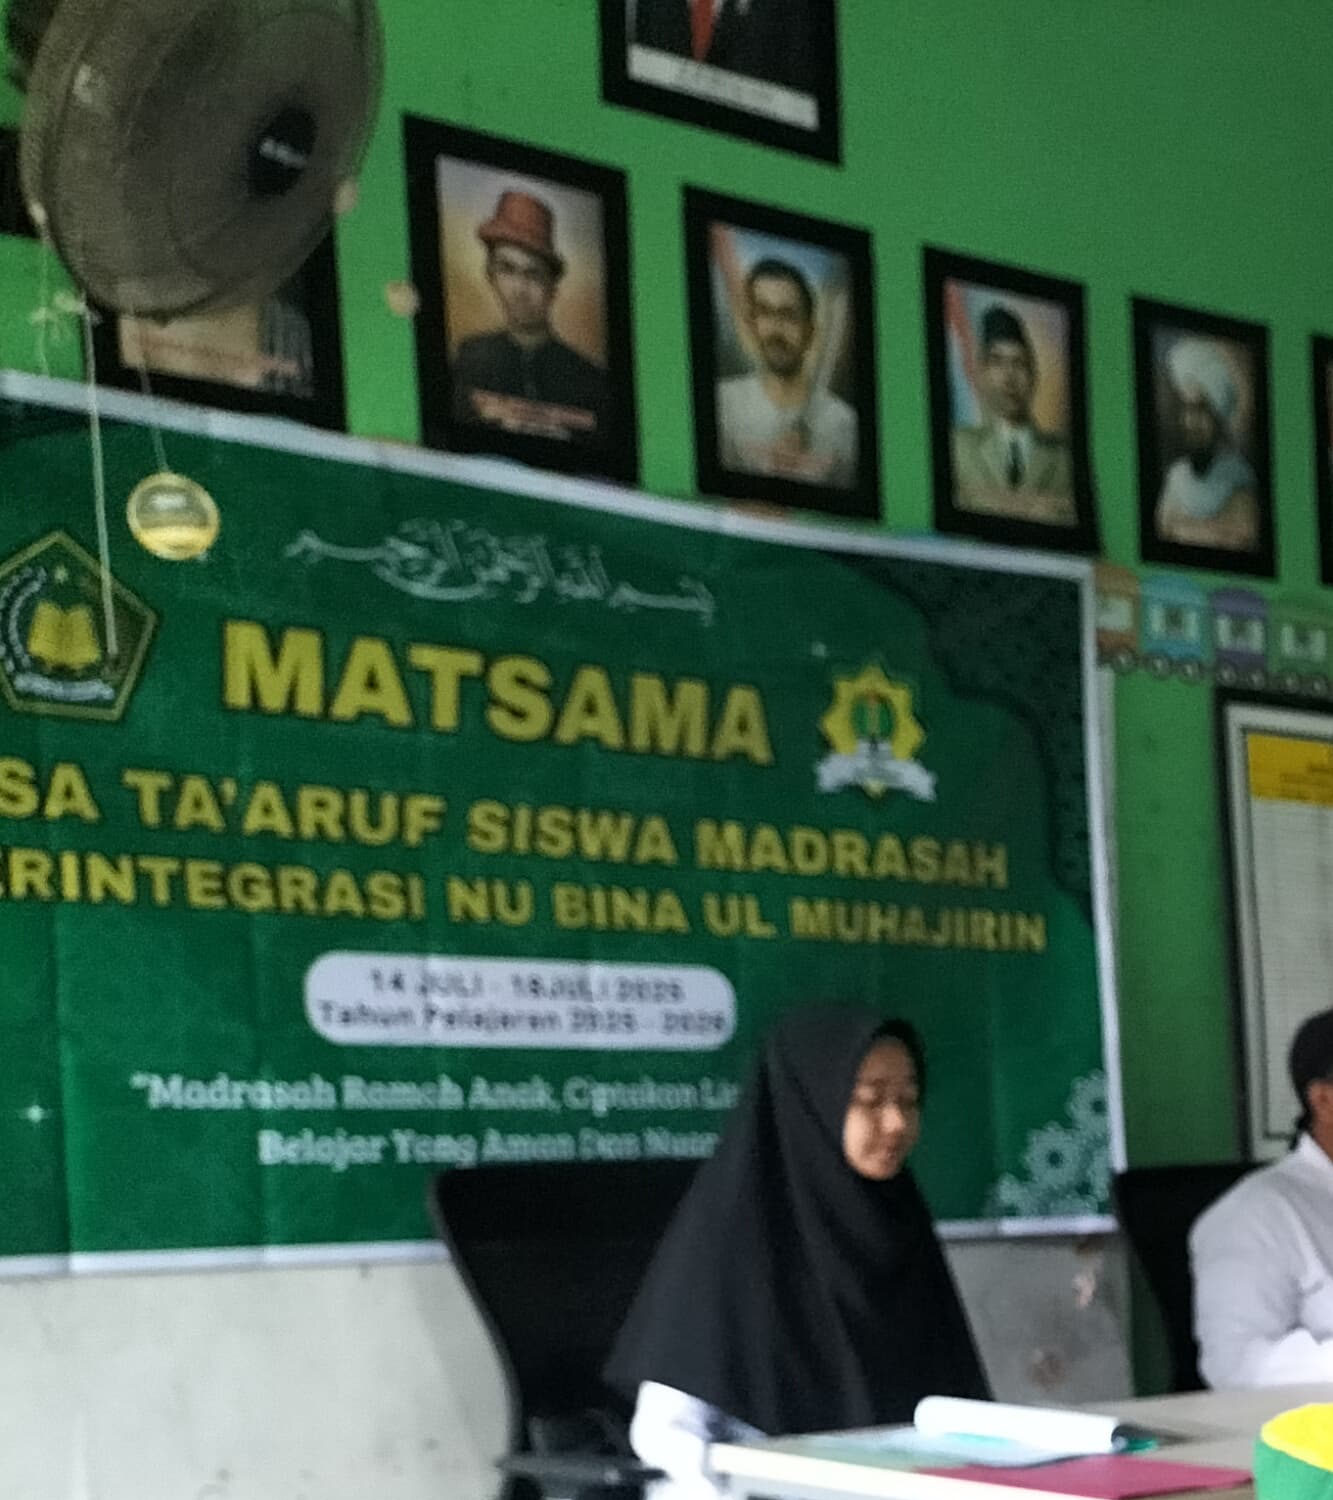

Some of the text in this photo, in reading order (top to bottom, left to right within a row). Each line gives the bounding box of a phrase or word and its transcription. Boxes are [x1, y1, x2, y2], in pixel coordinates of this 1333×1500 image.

[222, 619, 774, 766] MATSAMA
[122, 768, 447, 847] TA'ARUF
[466, 799, 678, 866] SISWA
[695, 818, 1008, 890] MADRASAH
[0, 847, 1047, 952] RINTEGRASI NU BINA UL MUHAJIRIN
